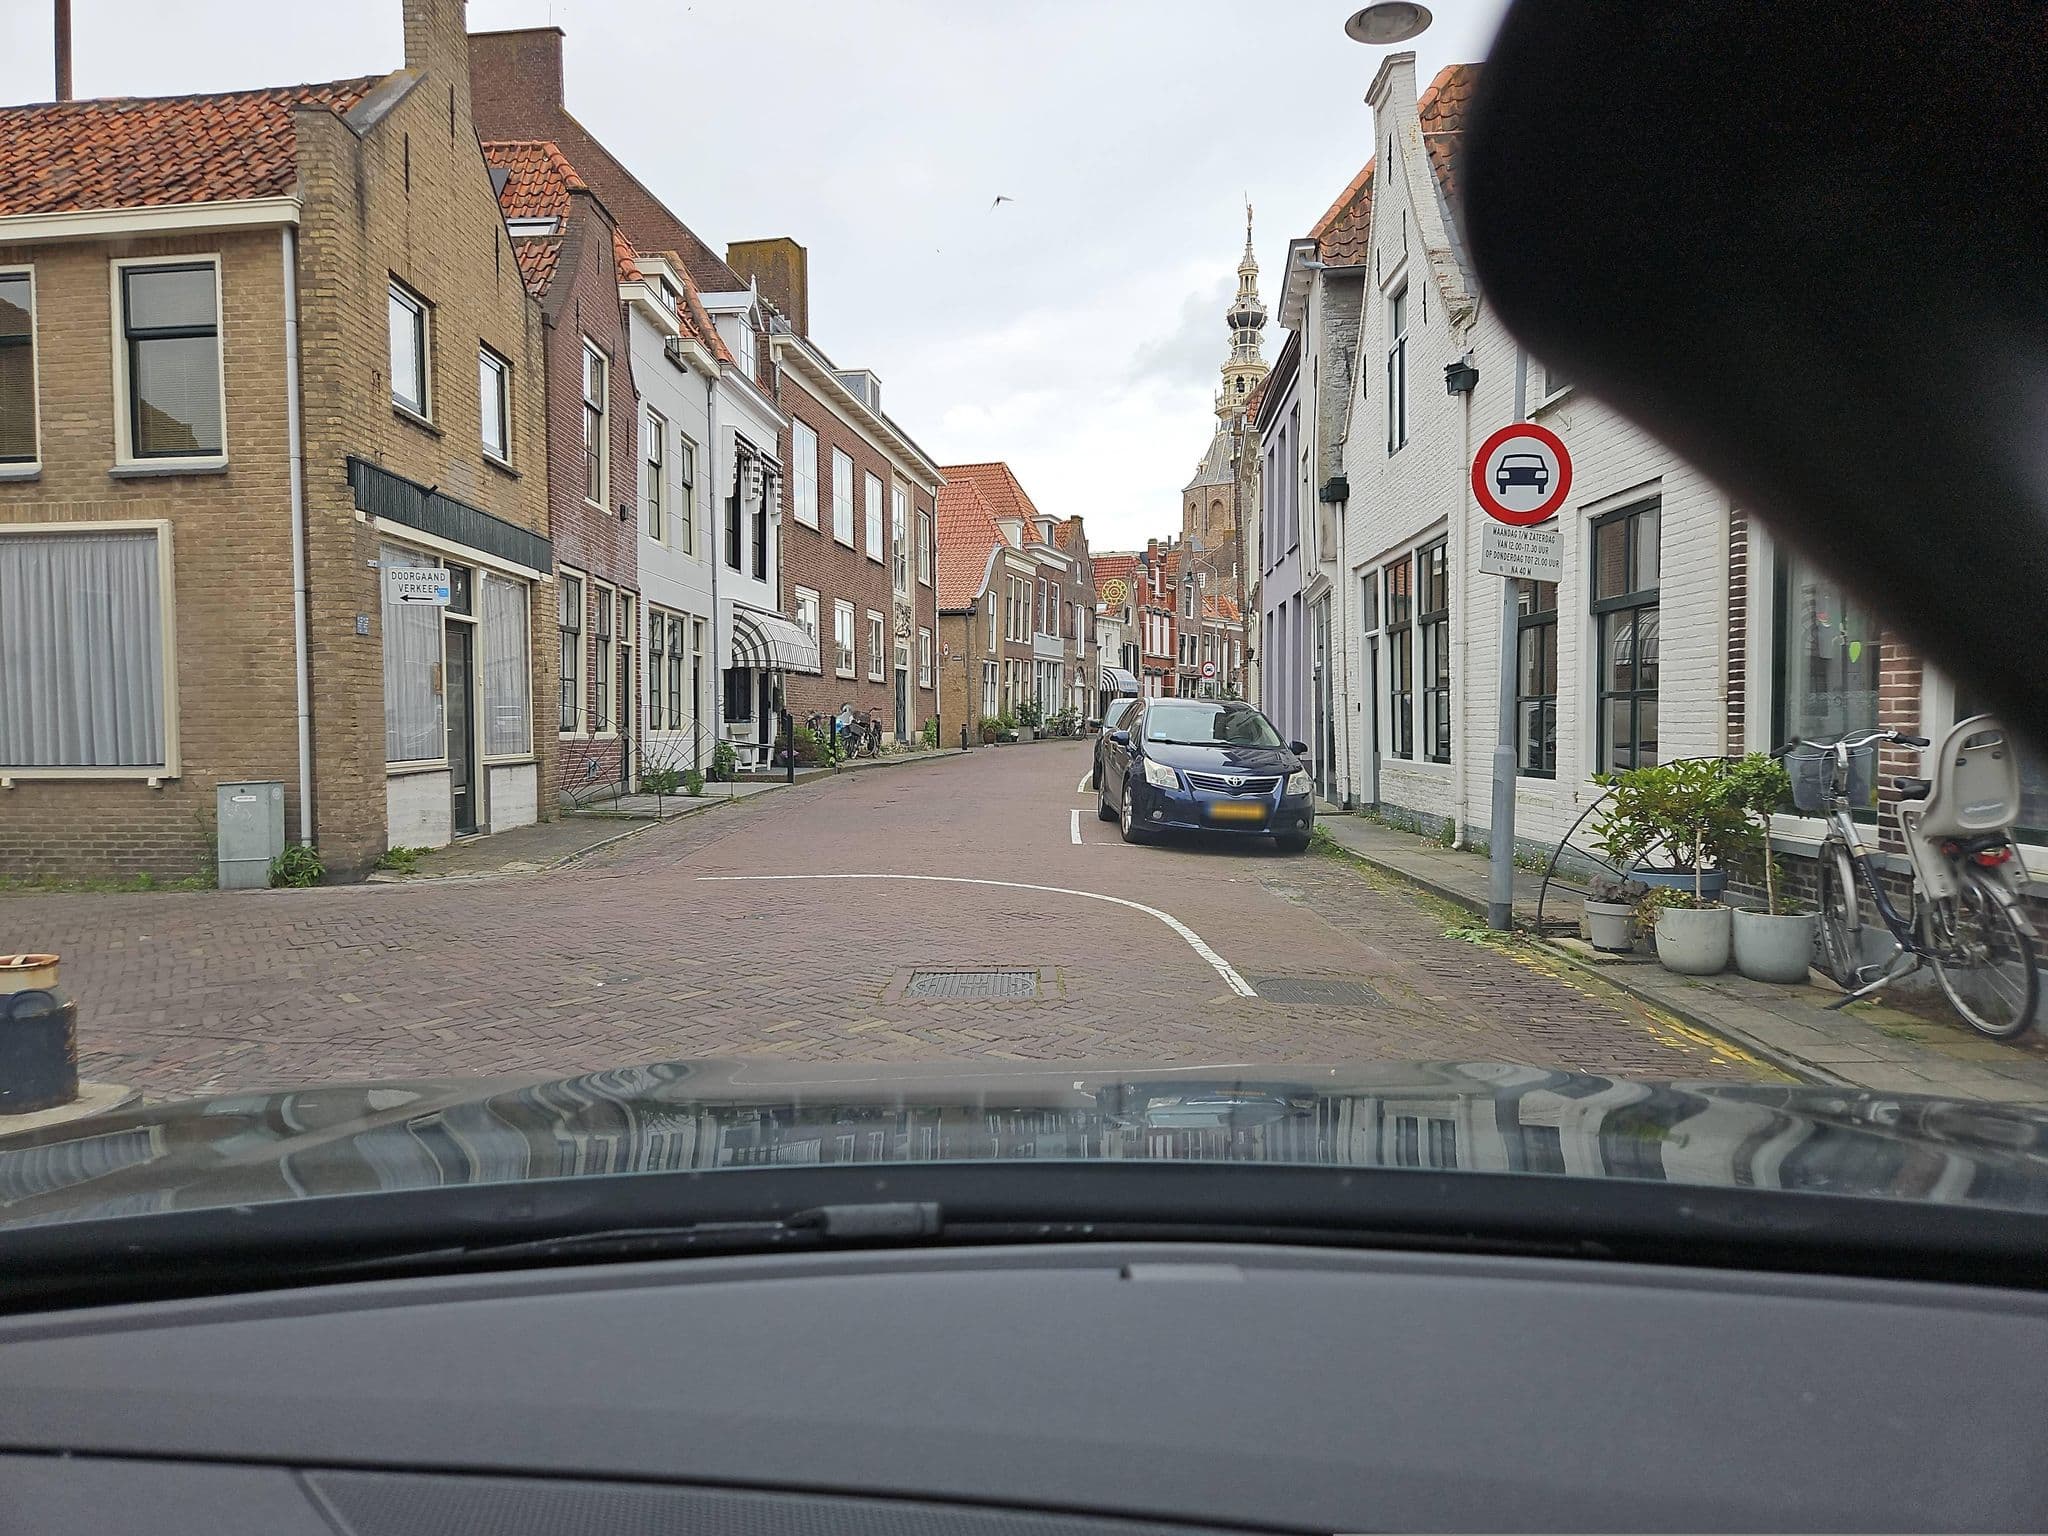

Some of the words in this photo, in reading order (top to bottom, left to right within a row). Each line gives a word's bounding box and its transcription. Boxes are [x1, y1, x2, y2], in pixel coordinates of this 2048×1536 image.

[1492, 526, 1518, 539] MAANDAG
[1529, 532, 1556, 544] ZATERDAG
[1497, 539, 1508, 549] VAN
[1538, 545, 1549, 554] UUR
[1485, 549, 1493, 558] OP
[1493, 550, 1524, 563] DONDERDAG
[1524, 555, 1534, 565] TOT
[1534, 557, 1548, 567] 21.00
[1548, 559, 1560, 569] UUR
[391, 571, 446, 582] DOORGAAND
[1510, 566, 1518, 575] NA
[1519, 567, 1527, 576] 40
[1527, 567, 1532, 576] M
[398, 583, 441, 594] VERKEER
